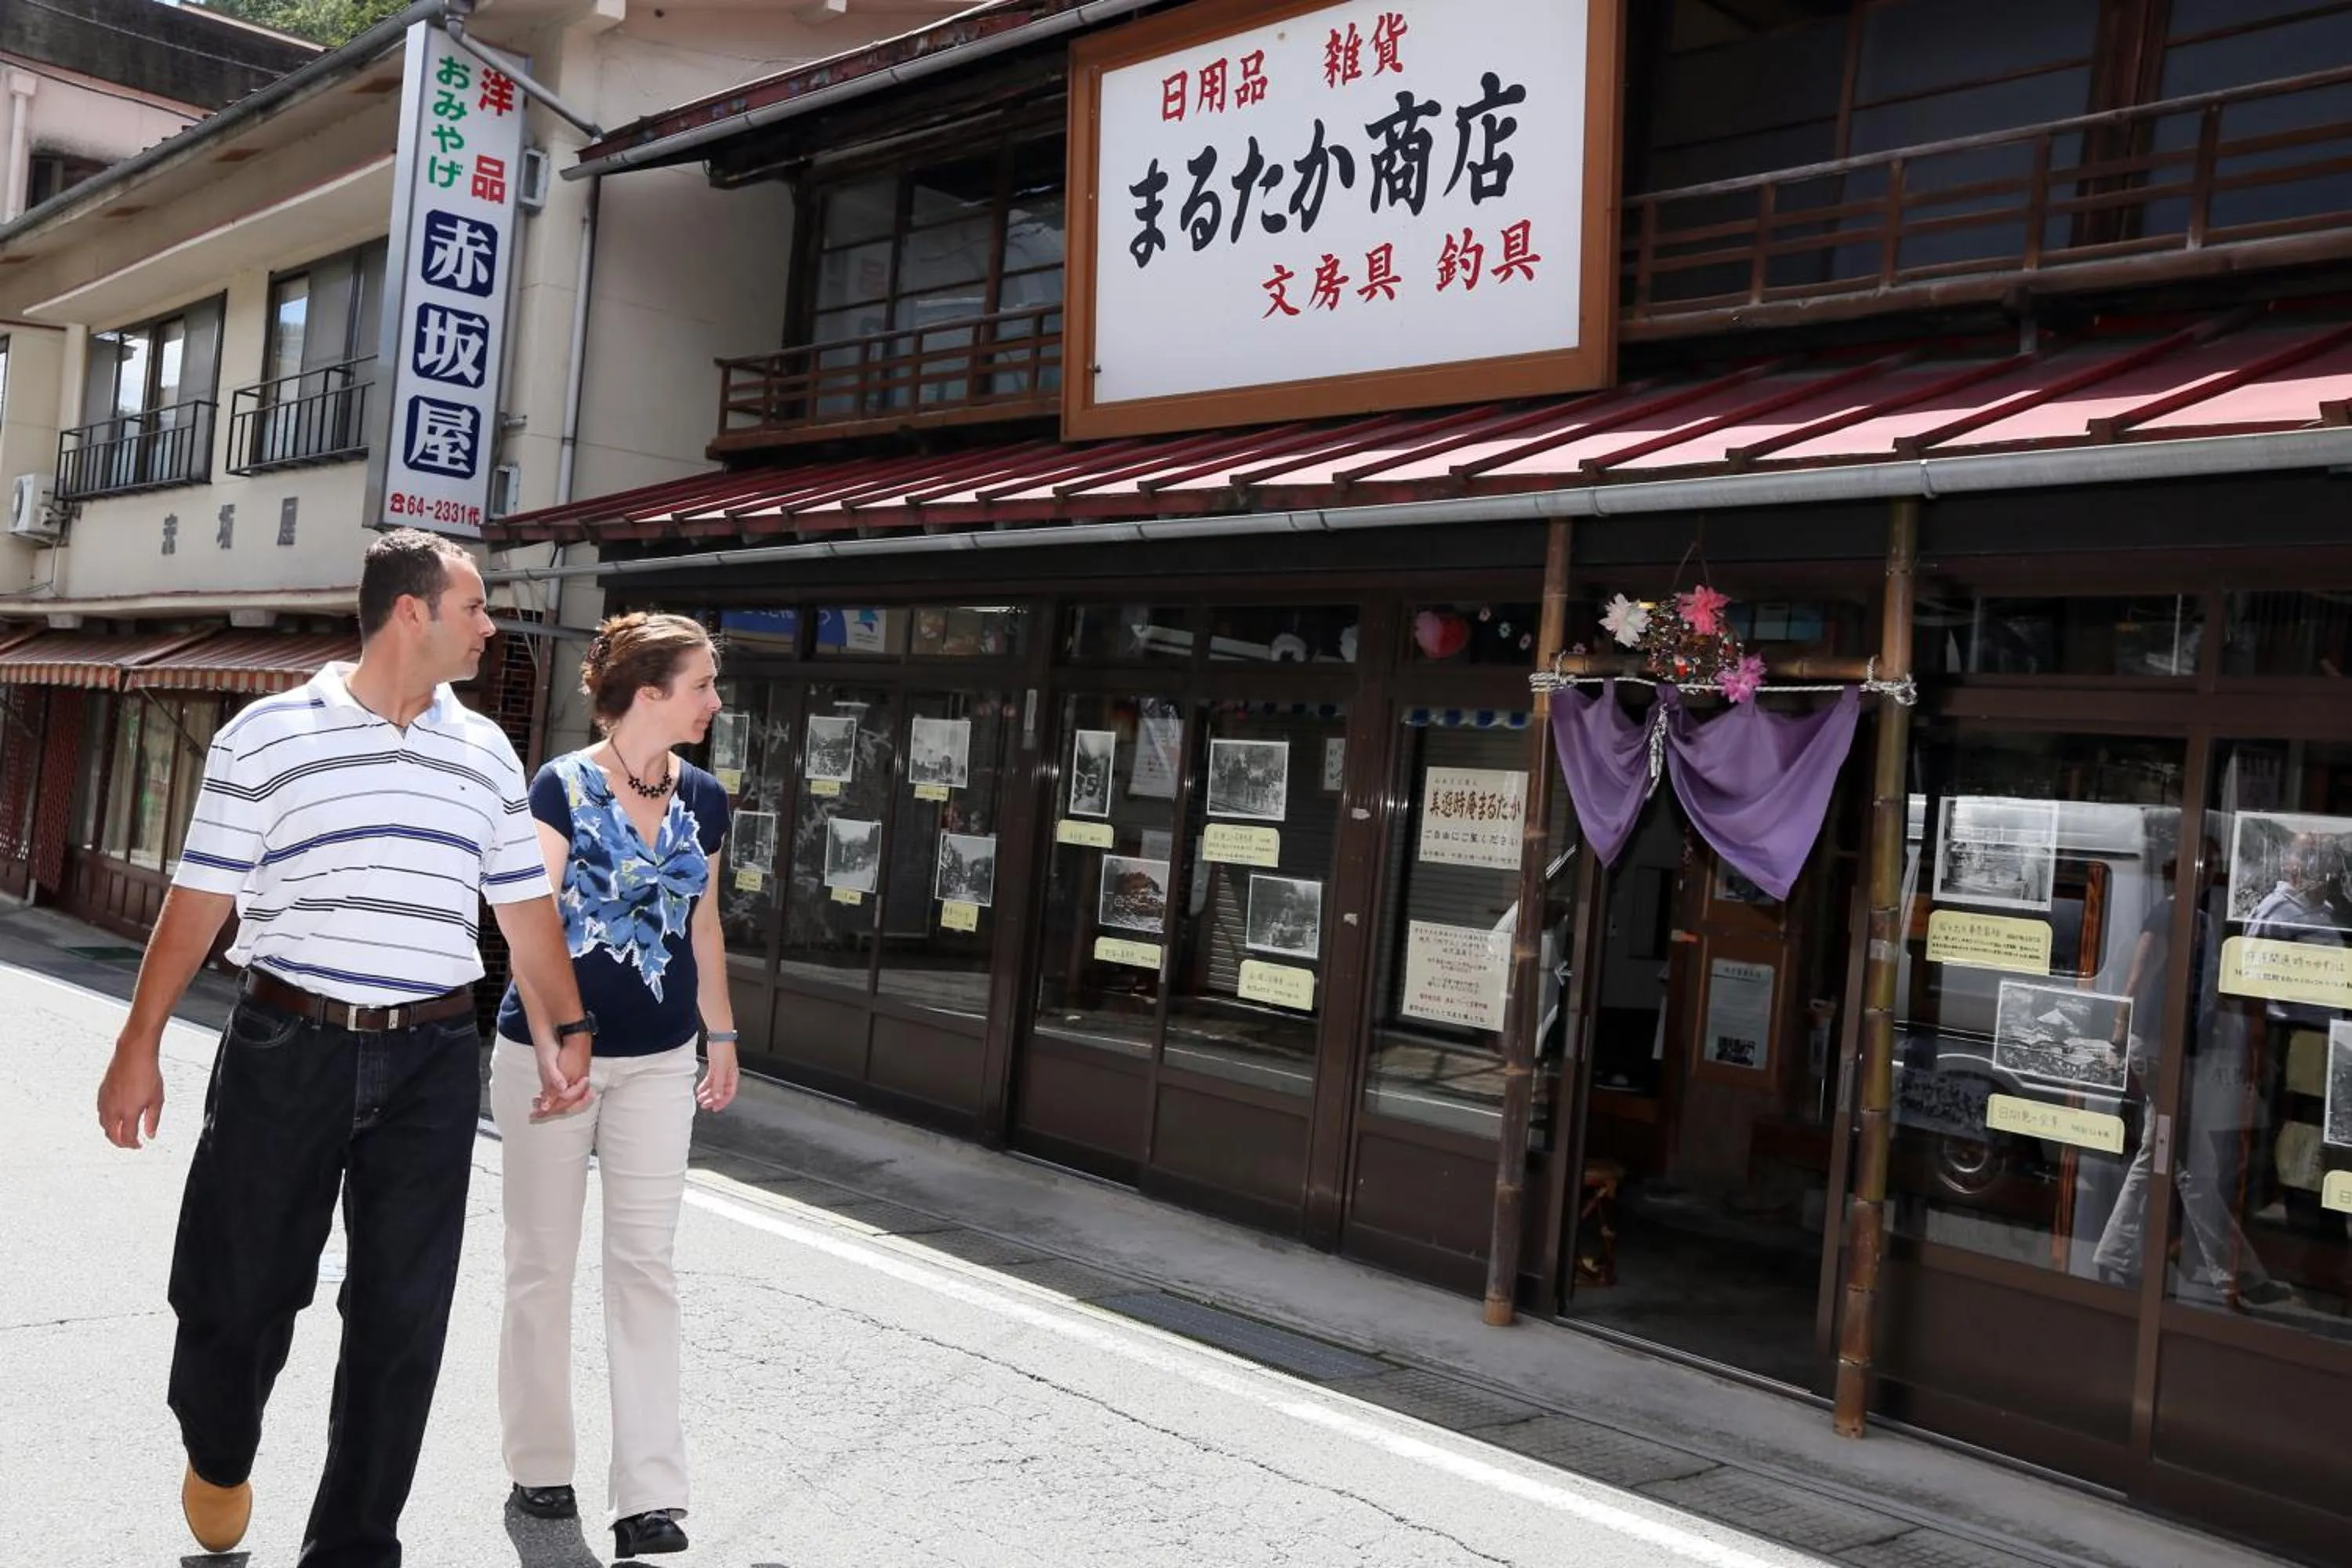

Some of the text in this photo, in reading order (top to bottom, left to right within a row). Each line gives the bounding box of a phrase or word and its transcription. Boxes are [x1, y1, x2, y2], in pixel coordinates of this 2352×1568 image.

[427, 56, 470, 190] おみやげ
[1161, 12, 1409, 122] 日用品 雑貨
[470, 67, 515, 205] 洋品
[1129, 71, 1526, 269] まるたか商店
[1261, 219, 1541, 320] 文房具 釣具
[407, 218, 493, 474] 赤坂屋
